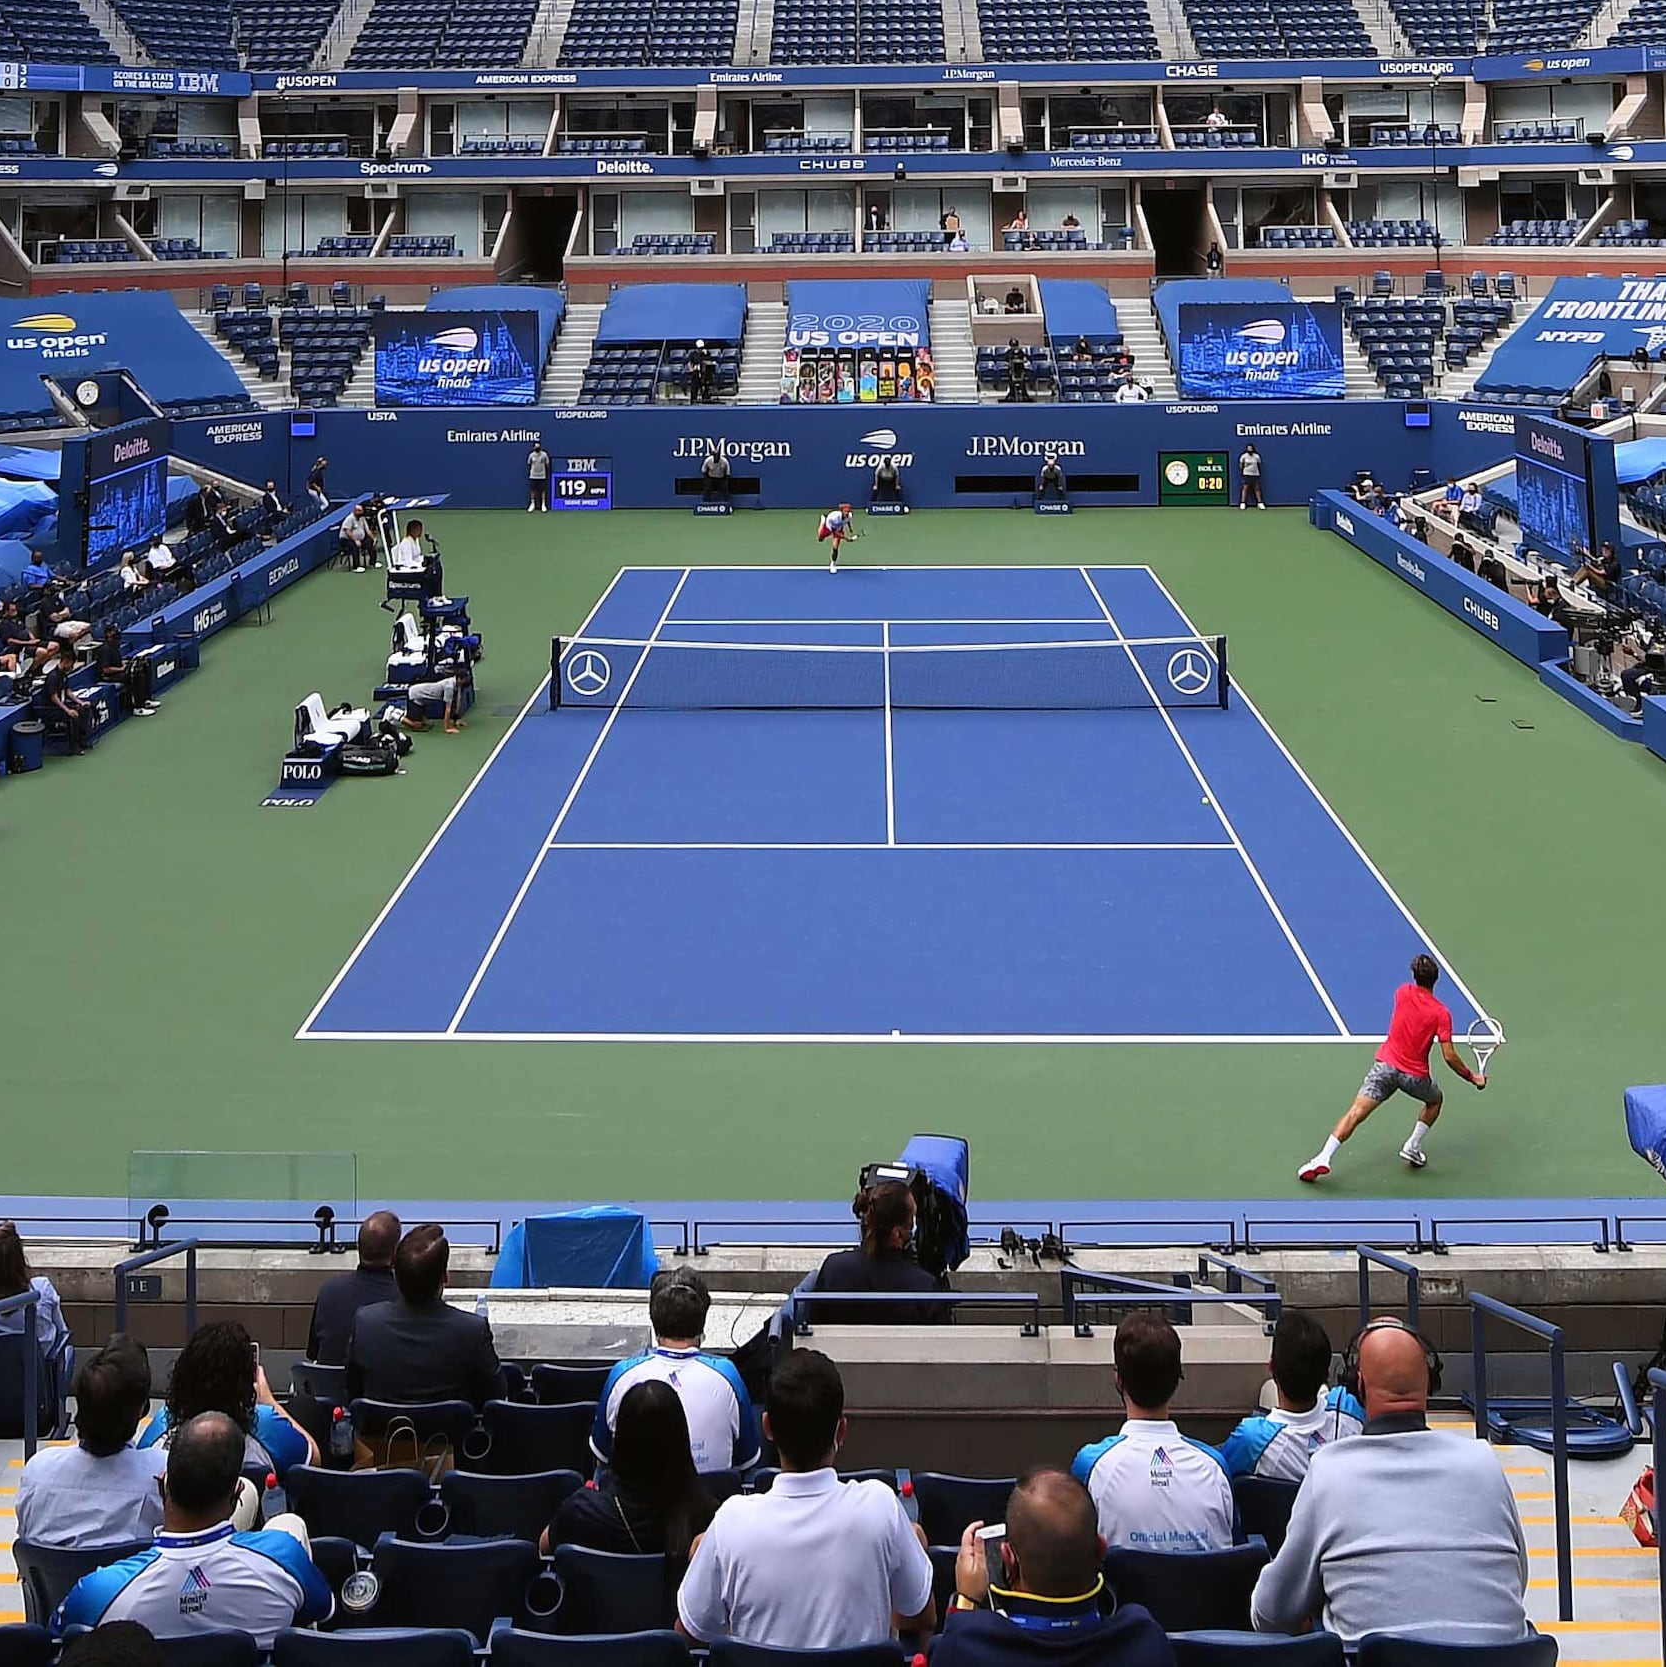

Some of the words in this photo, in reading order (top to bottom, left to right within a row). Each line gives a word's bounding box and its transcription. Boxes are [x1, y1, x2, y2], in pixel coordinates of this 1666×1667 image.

[942, 69, 995, 81] J.P.Morgan
[1166, 64, 1218, 77] CHASE
[178, 73, 218, 92] IBM
[476, 75, 529, 84] AMERICAN
[532, 75, 577, 84] EXPRESS
[710, 72, 749, 83] Emirates
[751, 72, 782, 83] Airline
[800, 160, 864, 170] CHUBB
[1050, 155, 1121, 168] Mercedes-Benz
[1301, 153, 1327, 165] IHG
[360, 161, 427, 176] Spectrum
[597, 160, 654, 174] Deloitte.
[791, 314, 920, 332] 2020
[789, 331, 829, 346] US
[838, 332, 919, 346] OPEN
[1535, 331, 1606, 344] NYPD
[42, 346, 91, 359] finals
[1245, 367, 1279, 381] finals
[437, 375, 471, 388] finals
[367, 412, 397, 421] USTA
[1458, 411, 1515, 424] AMERICAN
[206, 422, 262, 437] AMERICAN
[1236, 424, 1288, 436] Emirates
[1291, 422, 1331, 435] Airline
[1466, 422, 1515, 434] EXPRESS
[214, 431, 262, 445] EXPRESS
[447, 430, 497, 442] Emirates
[499, 429, 540, 442] Airline
[673, 437, 791, 461] J.P.Morgan
[966, 436, 1085, 458] J.P.Morgan
[567, 459, 596, 472] IBM
[559, 479, 586, 496] 119
[1198, 478, 1223, 489] 0:20
[1464, 597, 1499, 631] CHUBB
[193, 609, 209, 633] IHG
[283, 762, 321, 780] POLO
[260, 797, 314, 808] POLO
[130, 1281, 135, 1292] 1
[139, 1281, 148, 1292] E
